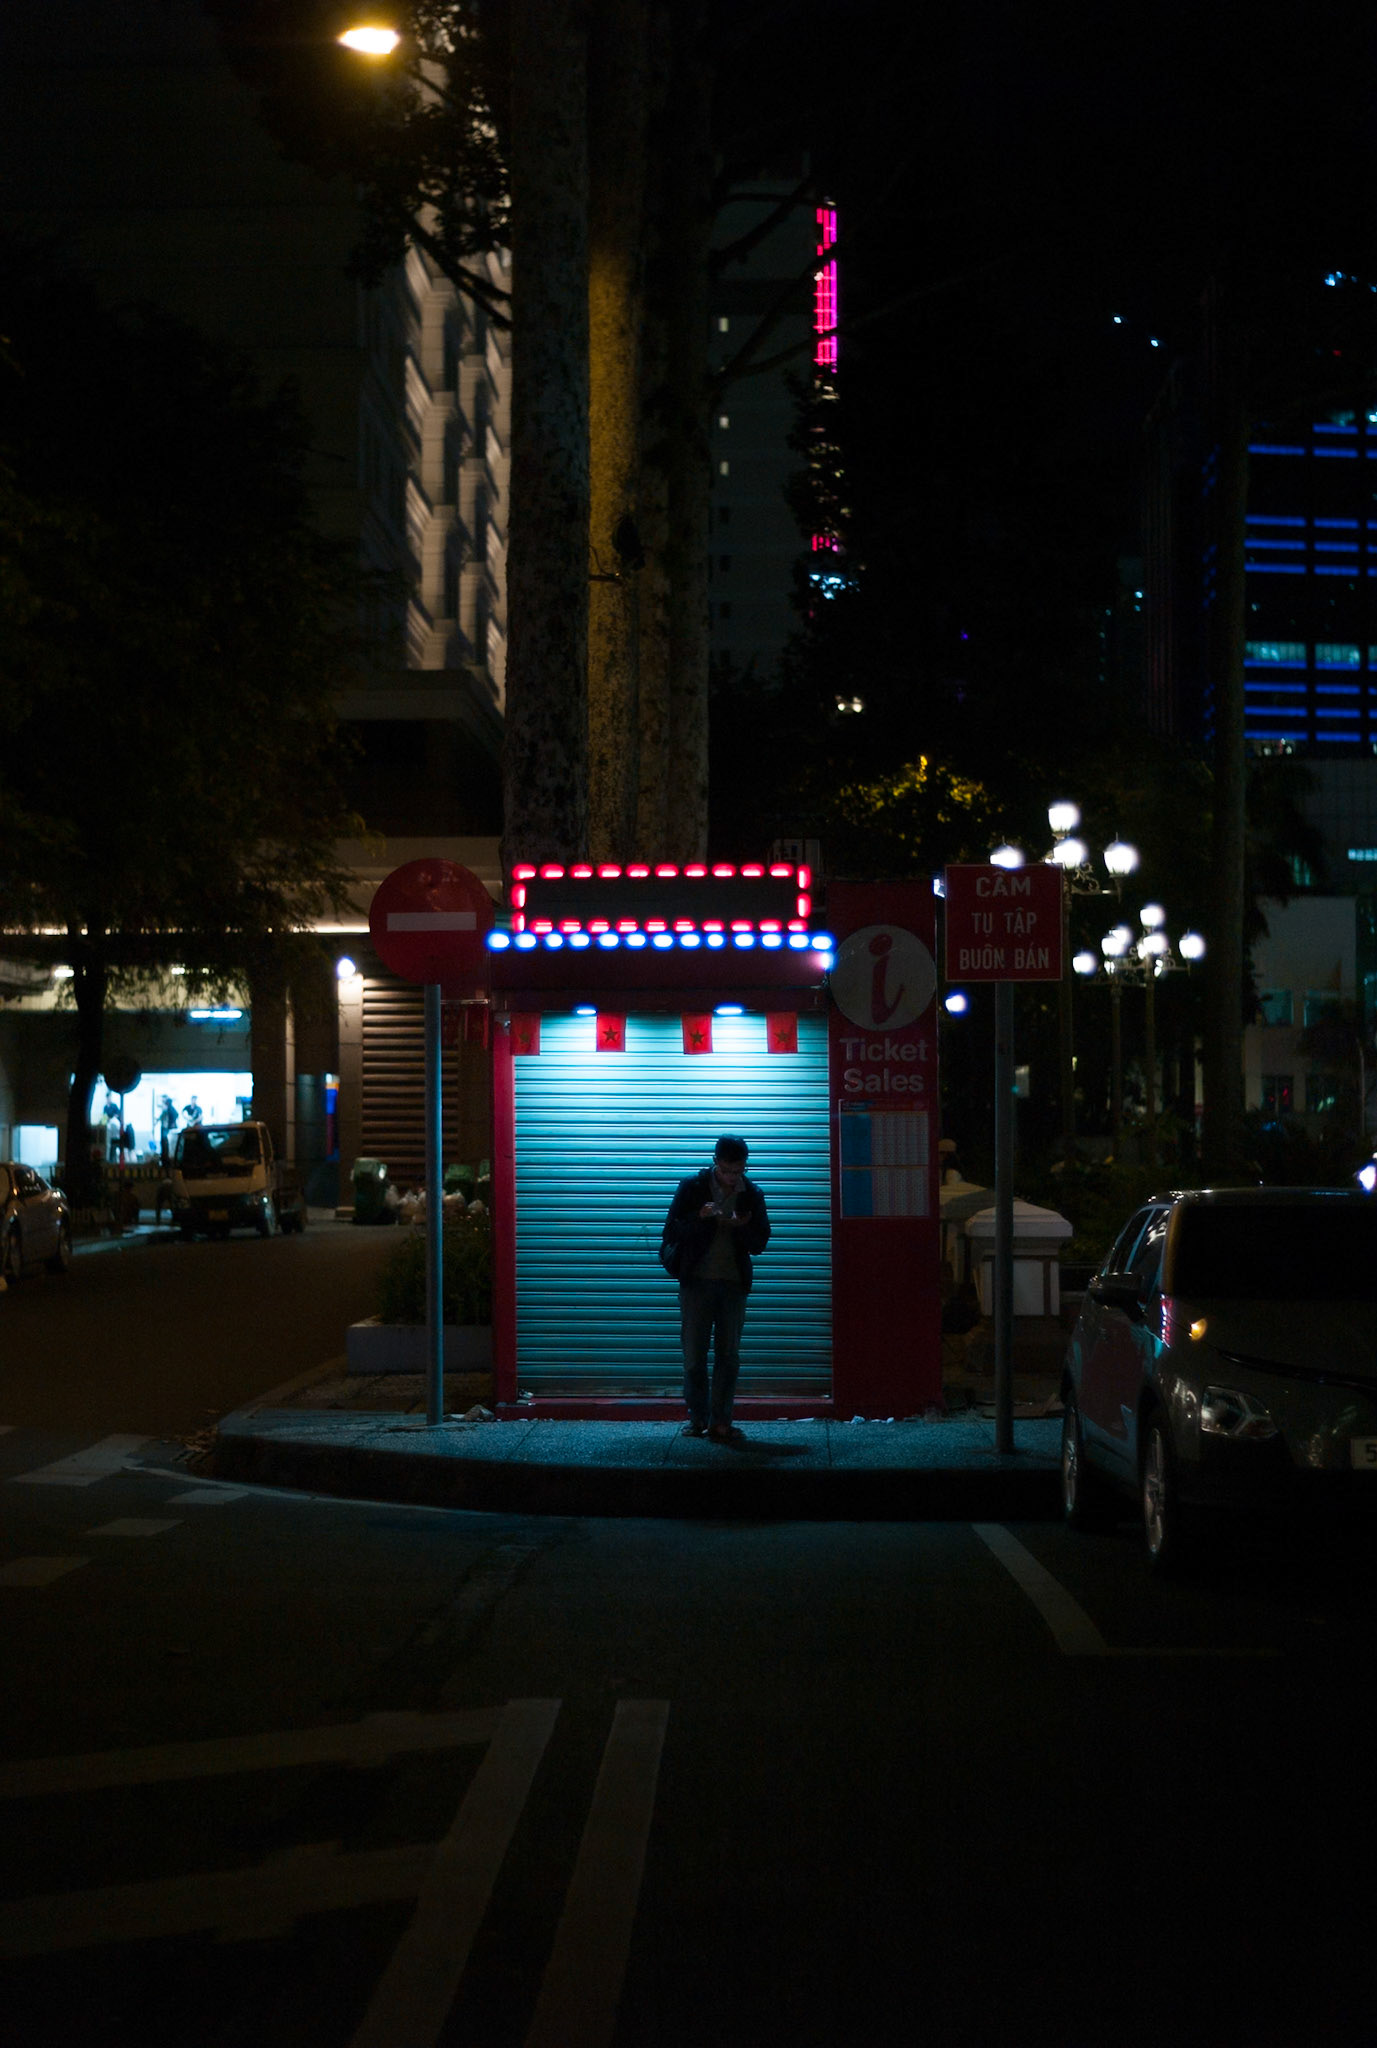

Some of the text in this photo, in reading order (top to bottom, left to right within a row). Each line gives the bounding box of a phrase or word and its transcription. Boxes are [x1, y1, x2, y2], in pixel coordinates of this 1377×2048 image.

[971, 911, 993, 938] TỤ
[960, 941, 1049, 970] BUÔN BÁN
[840, 1037, 929, 1062] Ticket
[844, 1068, 925, 1093] Sales
